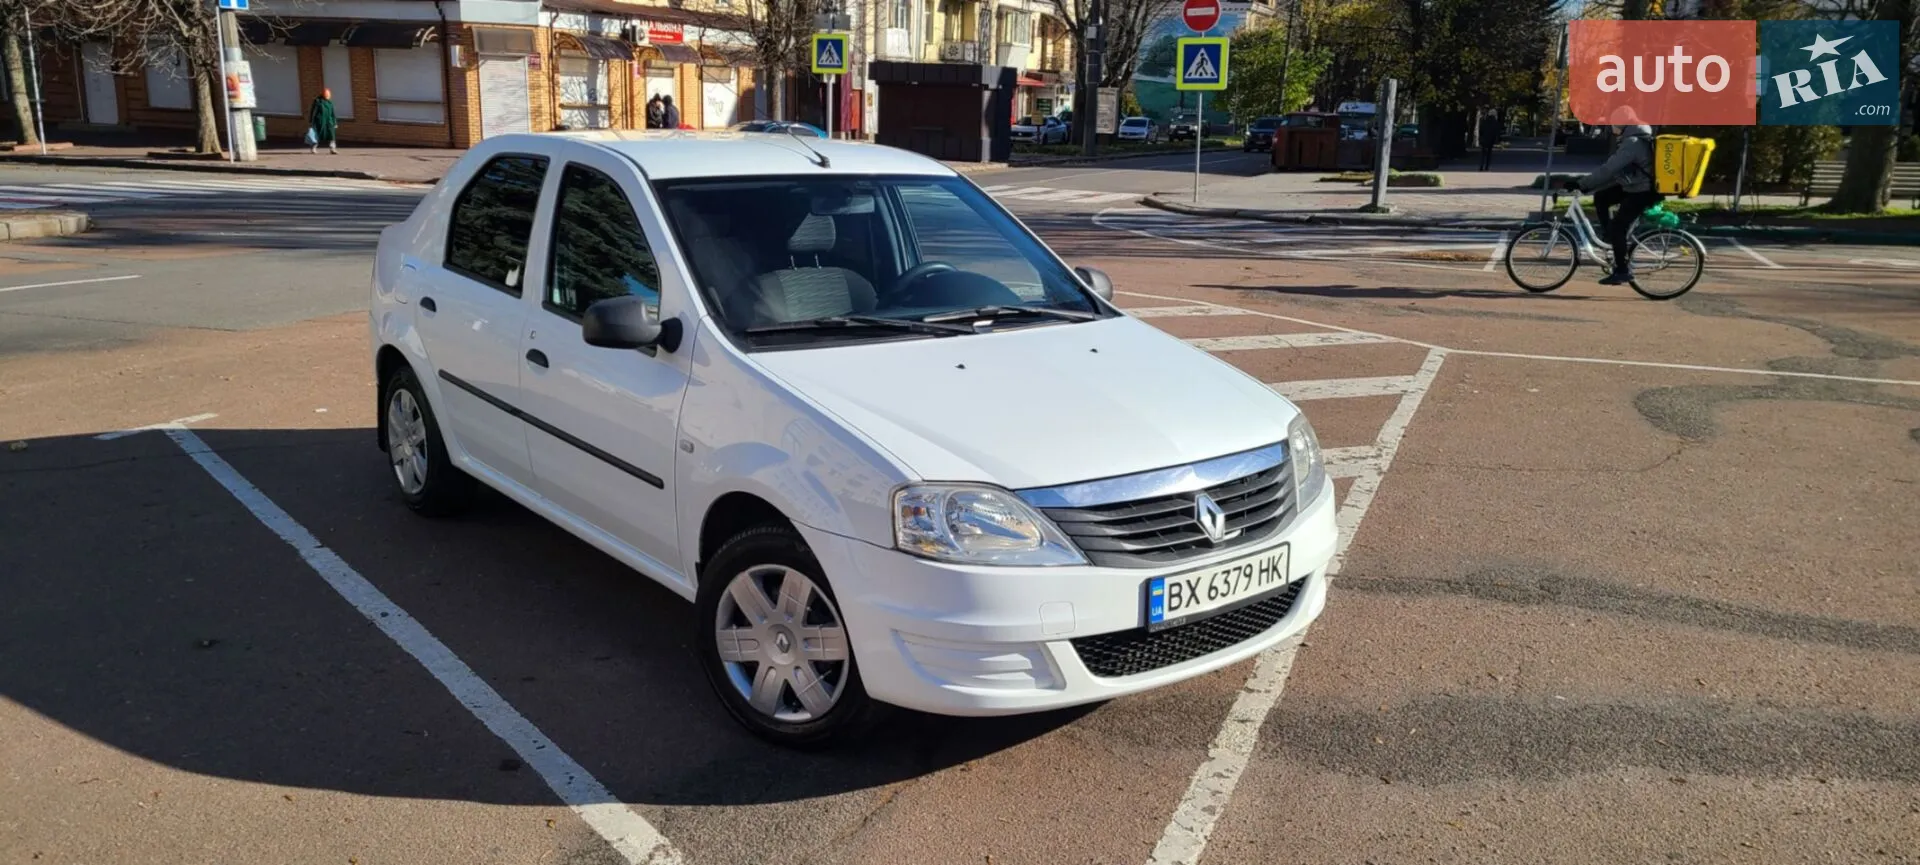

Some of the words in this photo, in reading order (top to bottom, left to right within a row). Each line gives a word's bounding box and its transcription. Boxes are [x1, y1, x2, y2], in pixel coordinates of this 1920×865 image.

[1168, 577, 1203, 612] BX
[1207, 563, 1254, 601] 6379
[1258, 552, 1284, 586] HK
[1152, 606, 1163, 616] UA
